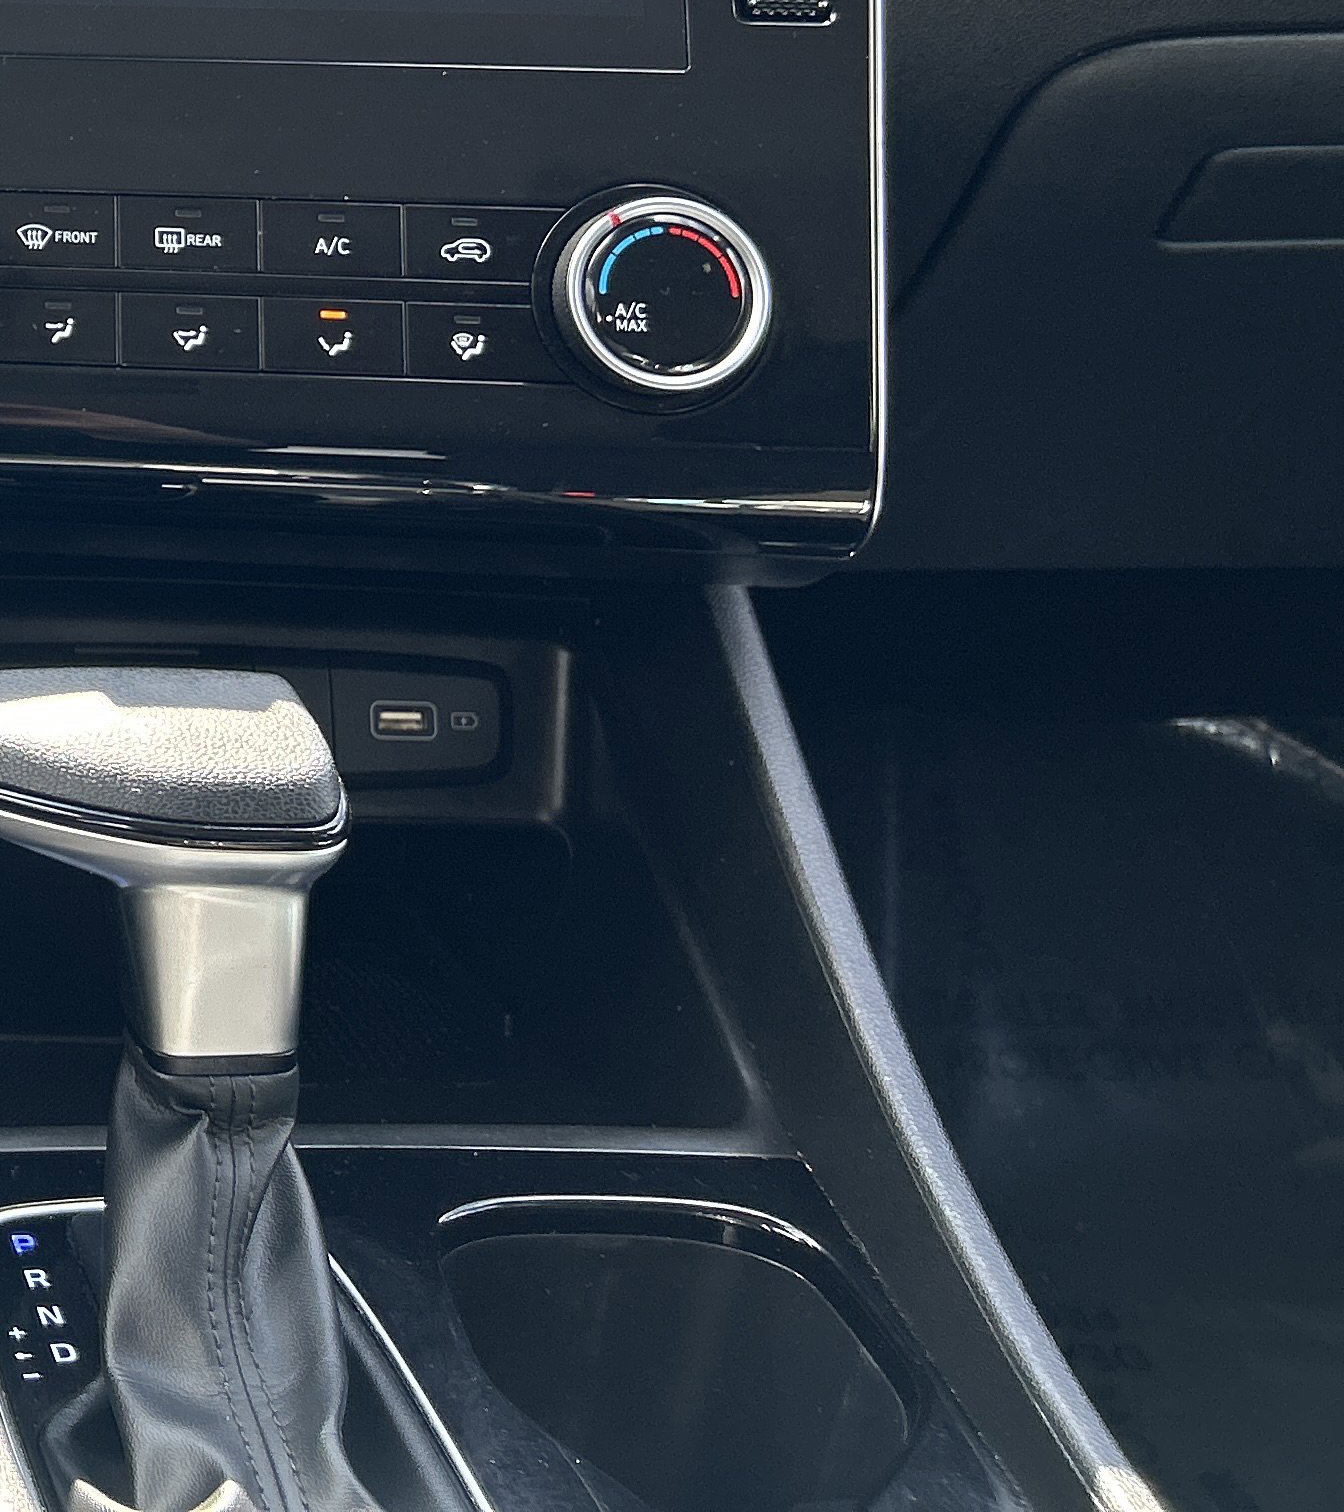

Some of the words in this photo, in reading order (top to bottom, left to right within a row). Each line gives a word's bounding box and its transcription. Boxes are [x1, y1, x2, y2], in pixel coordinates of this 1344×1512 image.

[54, 230, 99, 244] FRONT
[186, 233, 222, 248] REAR
[314, 236, 351, 256] A/C
[615, 302, 647, 320] A/C
[615, 319, 648, 333] MAX
[12, 1234, 37, 1255] P
[23, 1268, 52, 1289] R
[36, 1305, 66, 1327] N
[49, 1342, 80, 1364] D
